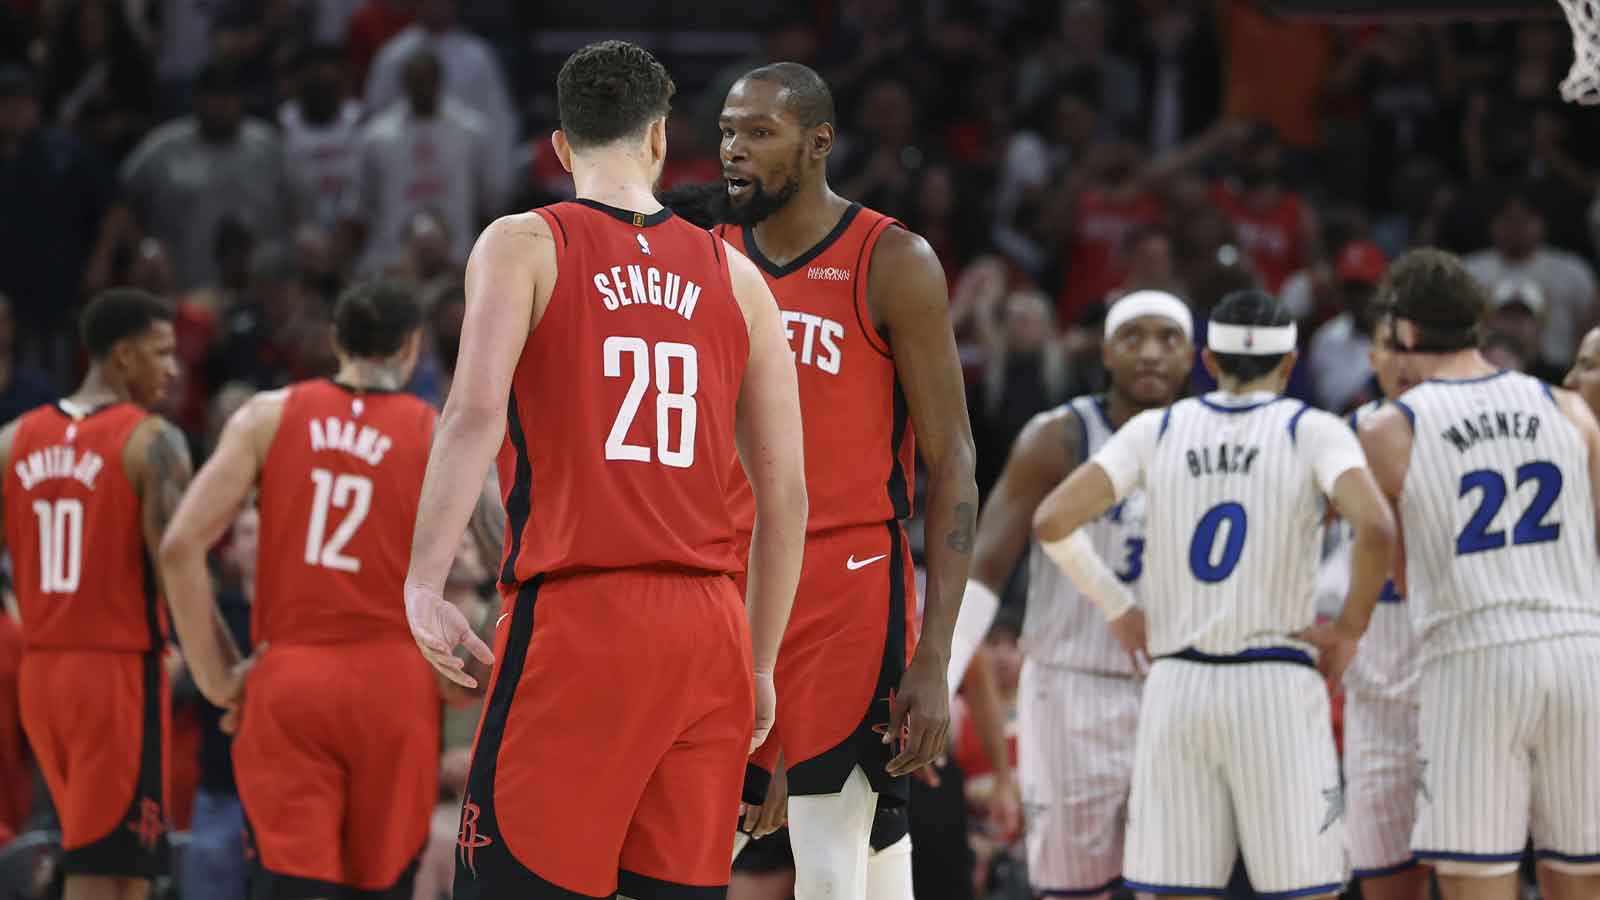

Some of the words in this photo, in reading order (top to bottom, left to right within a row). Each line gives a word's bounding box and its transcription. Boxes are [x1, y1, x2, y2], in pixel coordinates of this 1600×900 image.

[594, 265, 702, 320] SENGUN
[309, 416, 392, 466] ADAMS
[603, 336, 698, 468] 28
[1441, 411, 1541, 453] WAGNER
[1187, 443, 1259, 478] BLACK
[32, 499, 83, 593] 10
[304, 469, 373, 573] 12
[1189, 501, 1248, 584] 0
[1456, 461, 1562, 556] 22
